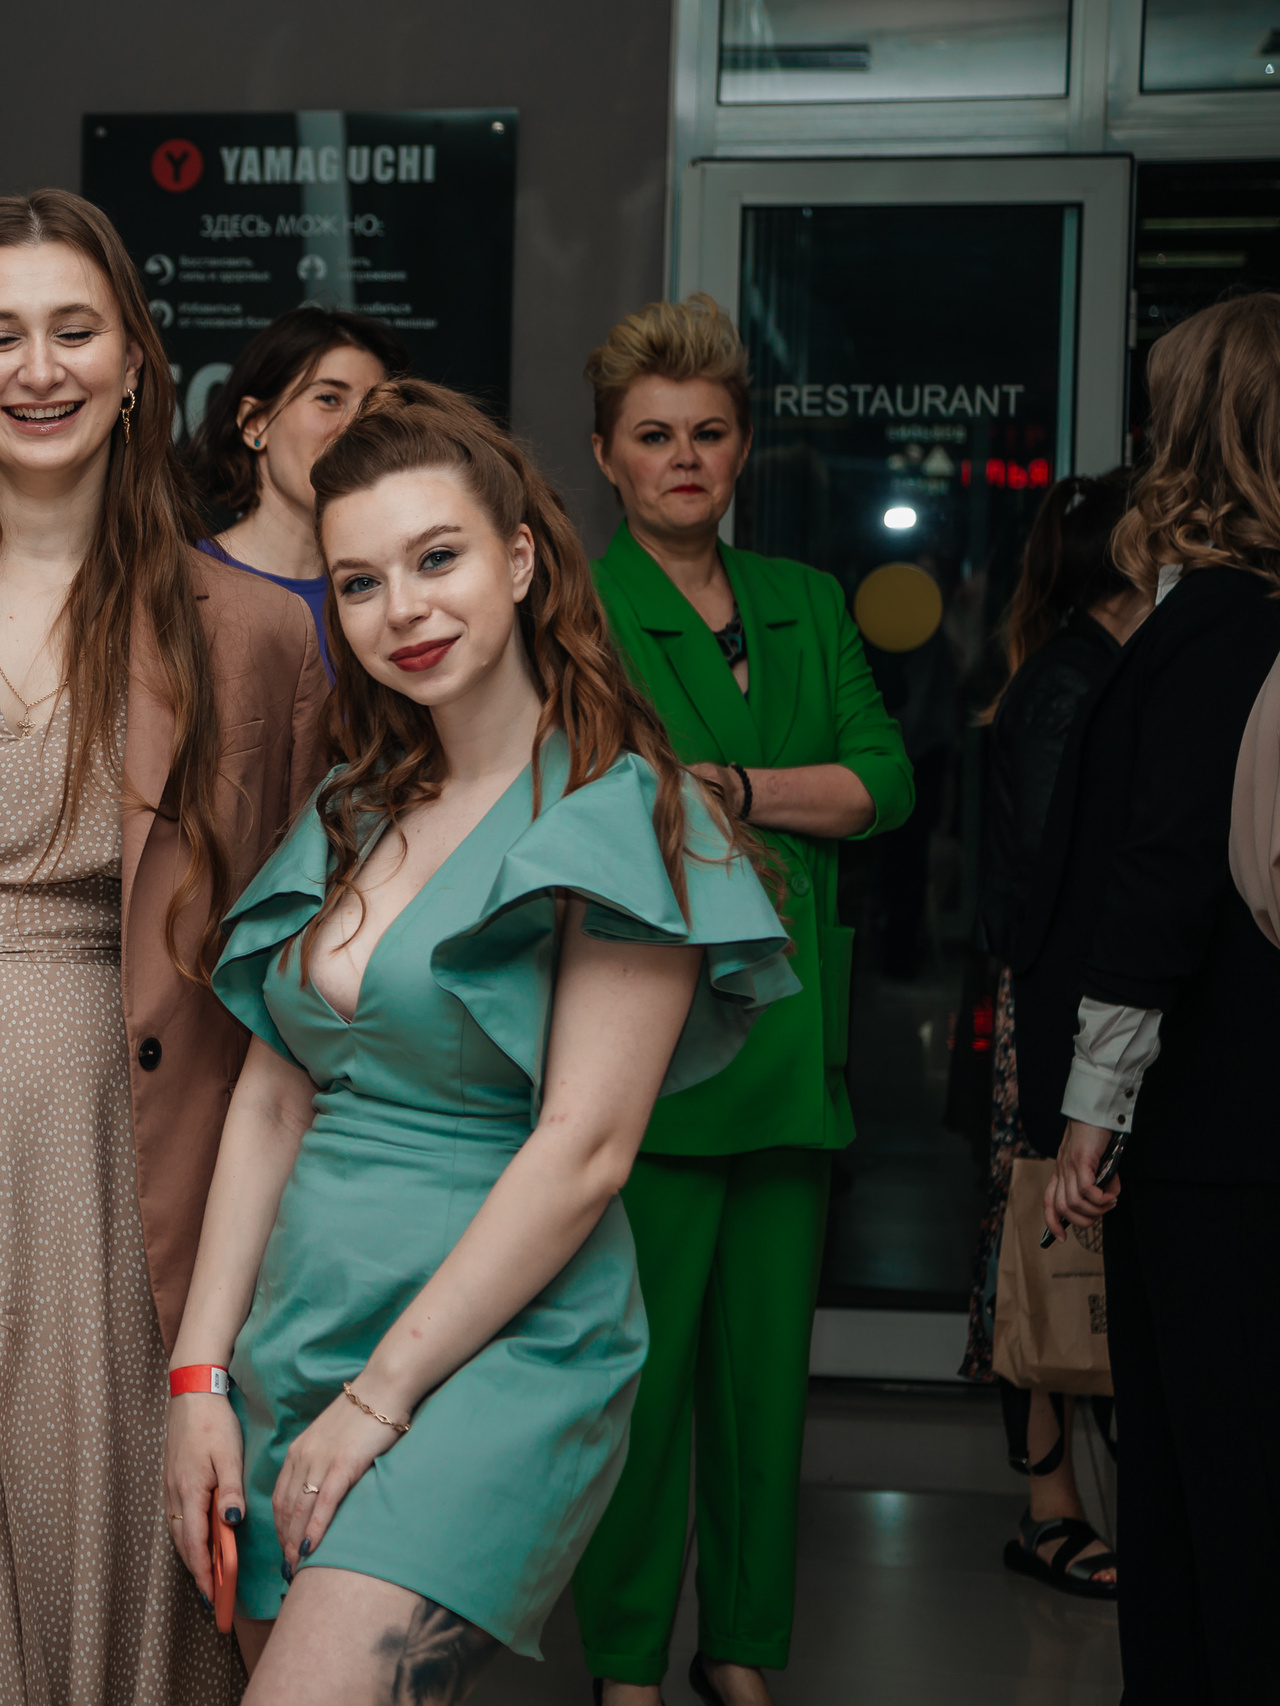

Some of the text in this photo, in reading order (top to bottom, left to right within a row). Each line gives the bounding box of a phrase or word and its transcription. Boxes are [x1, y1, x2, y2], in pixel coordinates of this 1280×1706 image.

[219, 144, 437, 185] YAMAGUCHI
[199, 213, 272, 241] ЗДЕСЬ
[774, 384, 1024, 418] RESTAURANT
